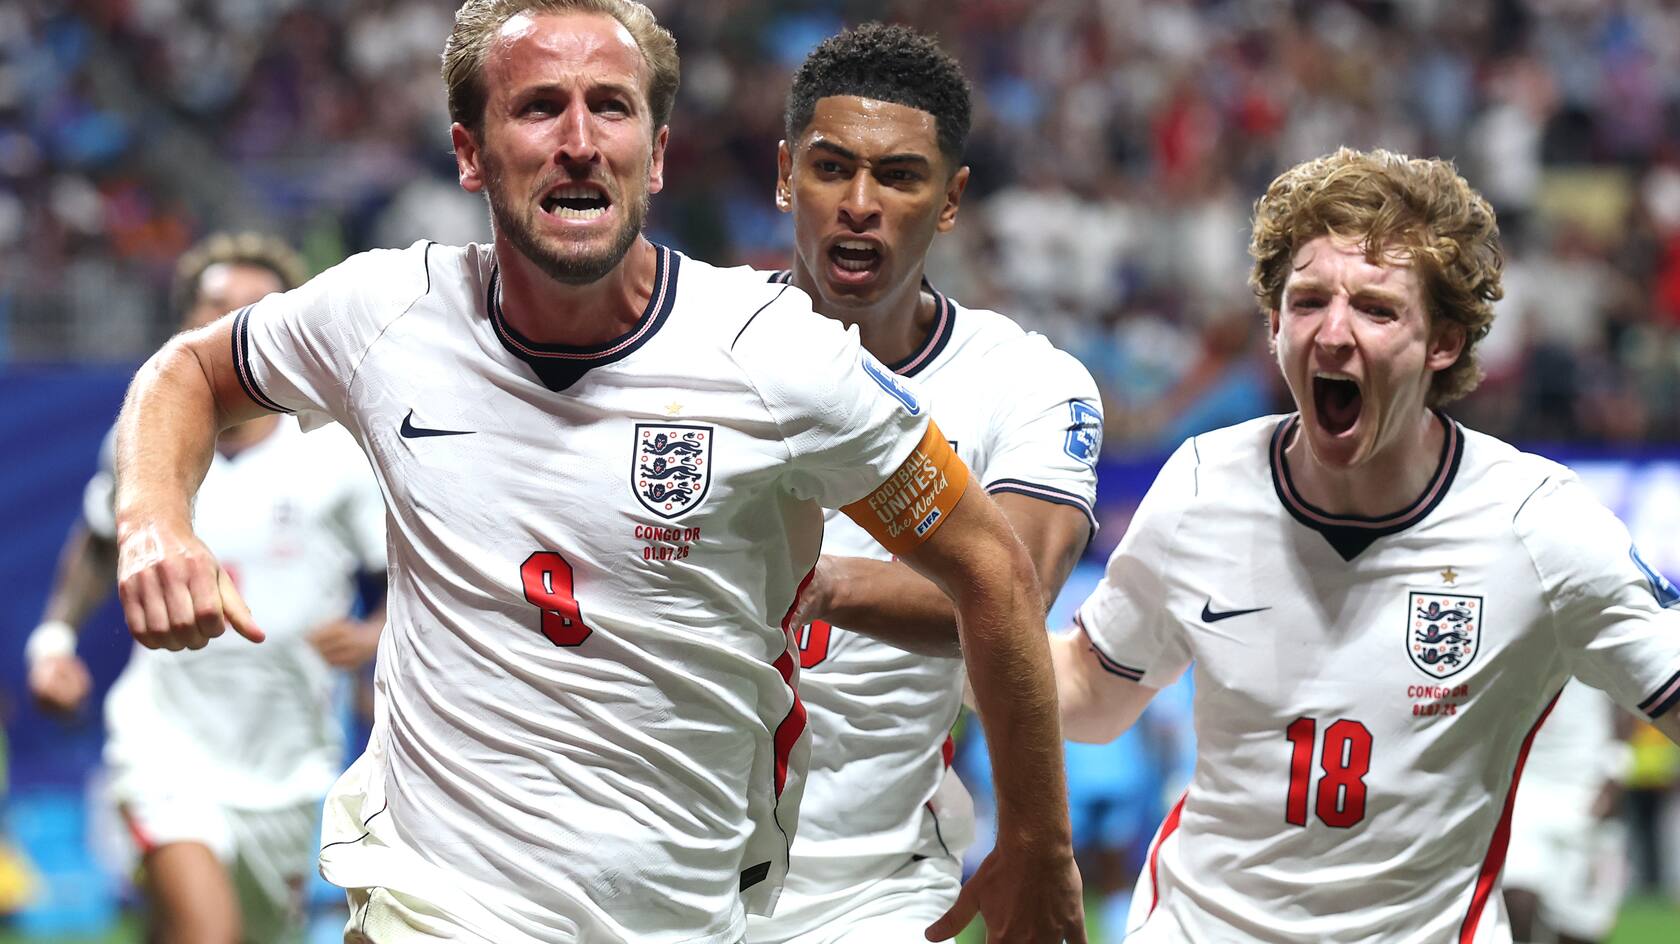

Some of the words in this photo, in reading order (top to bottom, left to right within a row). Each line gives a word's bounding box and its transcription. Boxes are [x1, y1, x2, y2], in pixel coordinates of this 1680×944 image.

[868, 449, 928, 510] FOOTBALL
[876, 458, 938, 523] UNITES
[886, 517, 912, 538] the
[911, 470, 949, 520] World
[917, 510, 940, 534] FIFA
[634, 525, 681, 541] CONGO
[684, 527, 701, 541] DR
[643, 545, 690, 560] 01.07.26
[1408, 685, 1450, 699] CONGO
[1452, 684, 1469, 697] DR
[1286, 717, 1373, 829] 18
